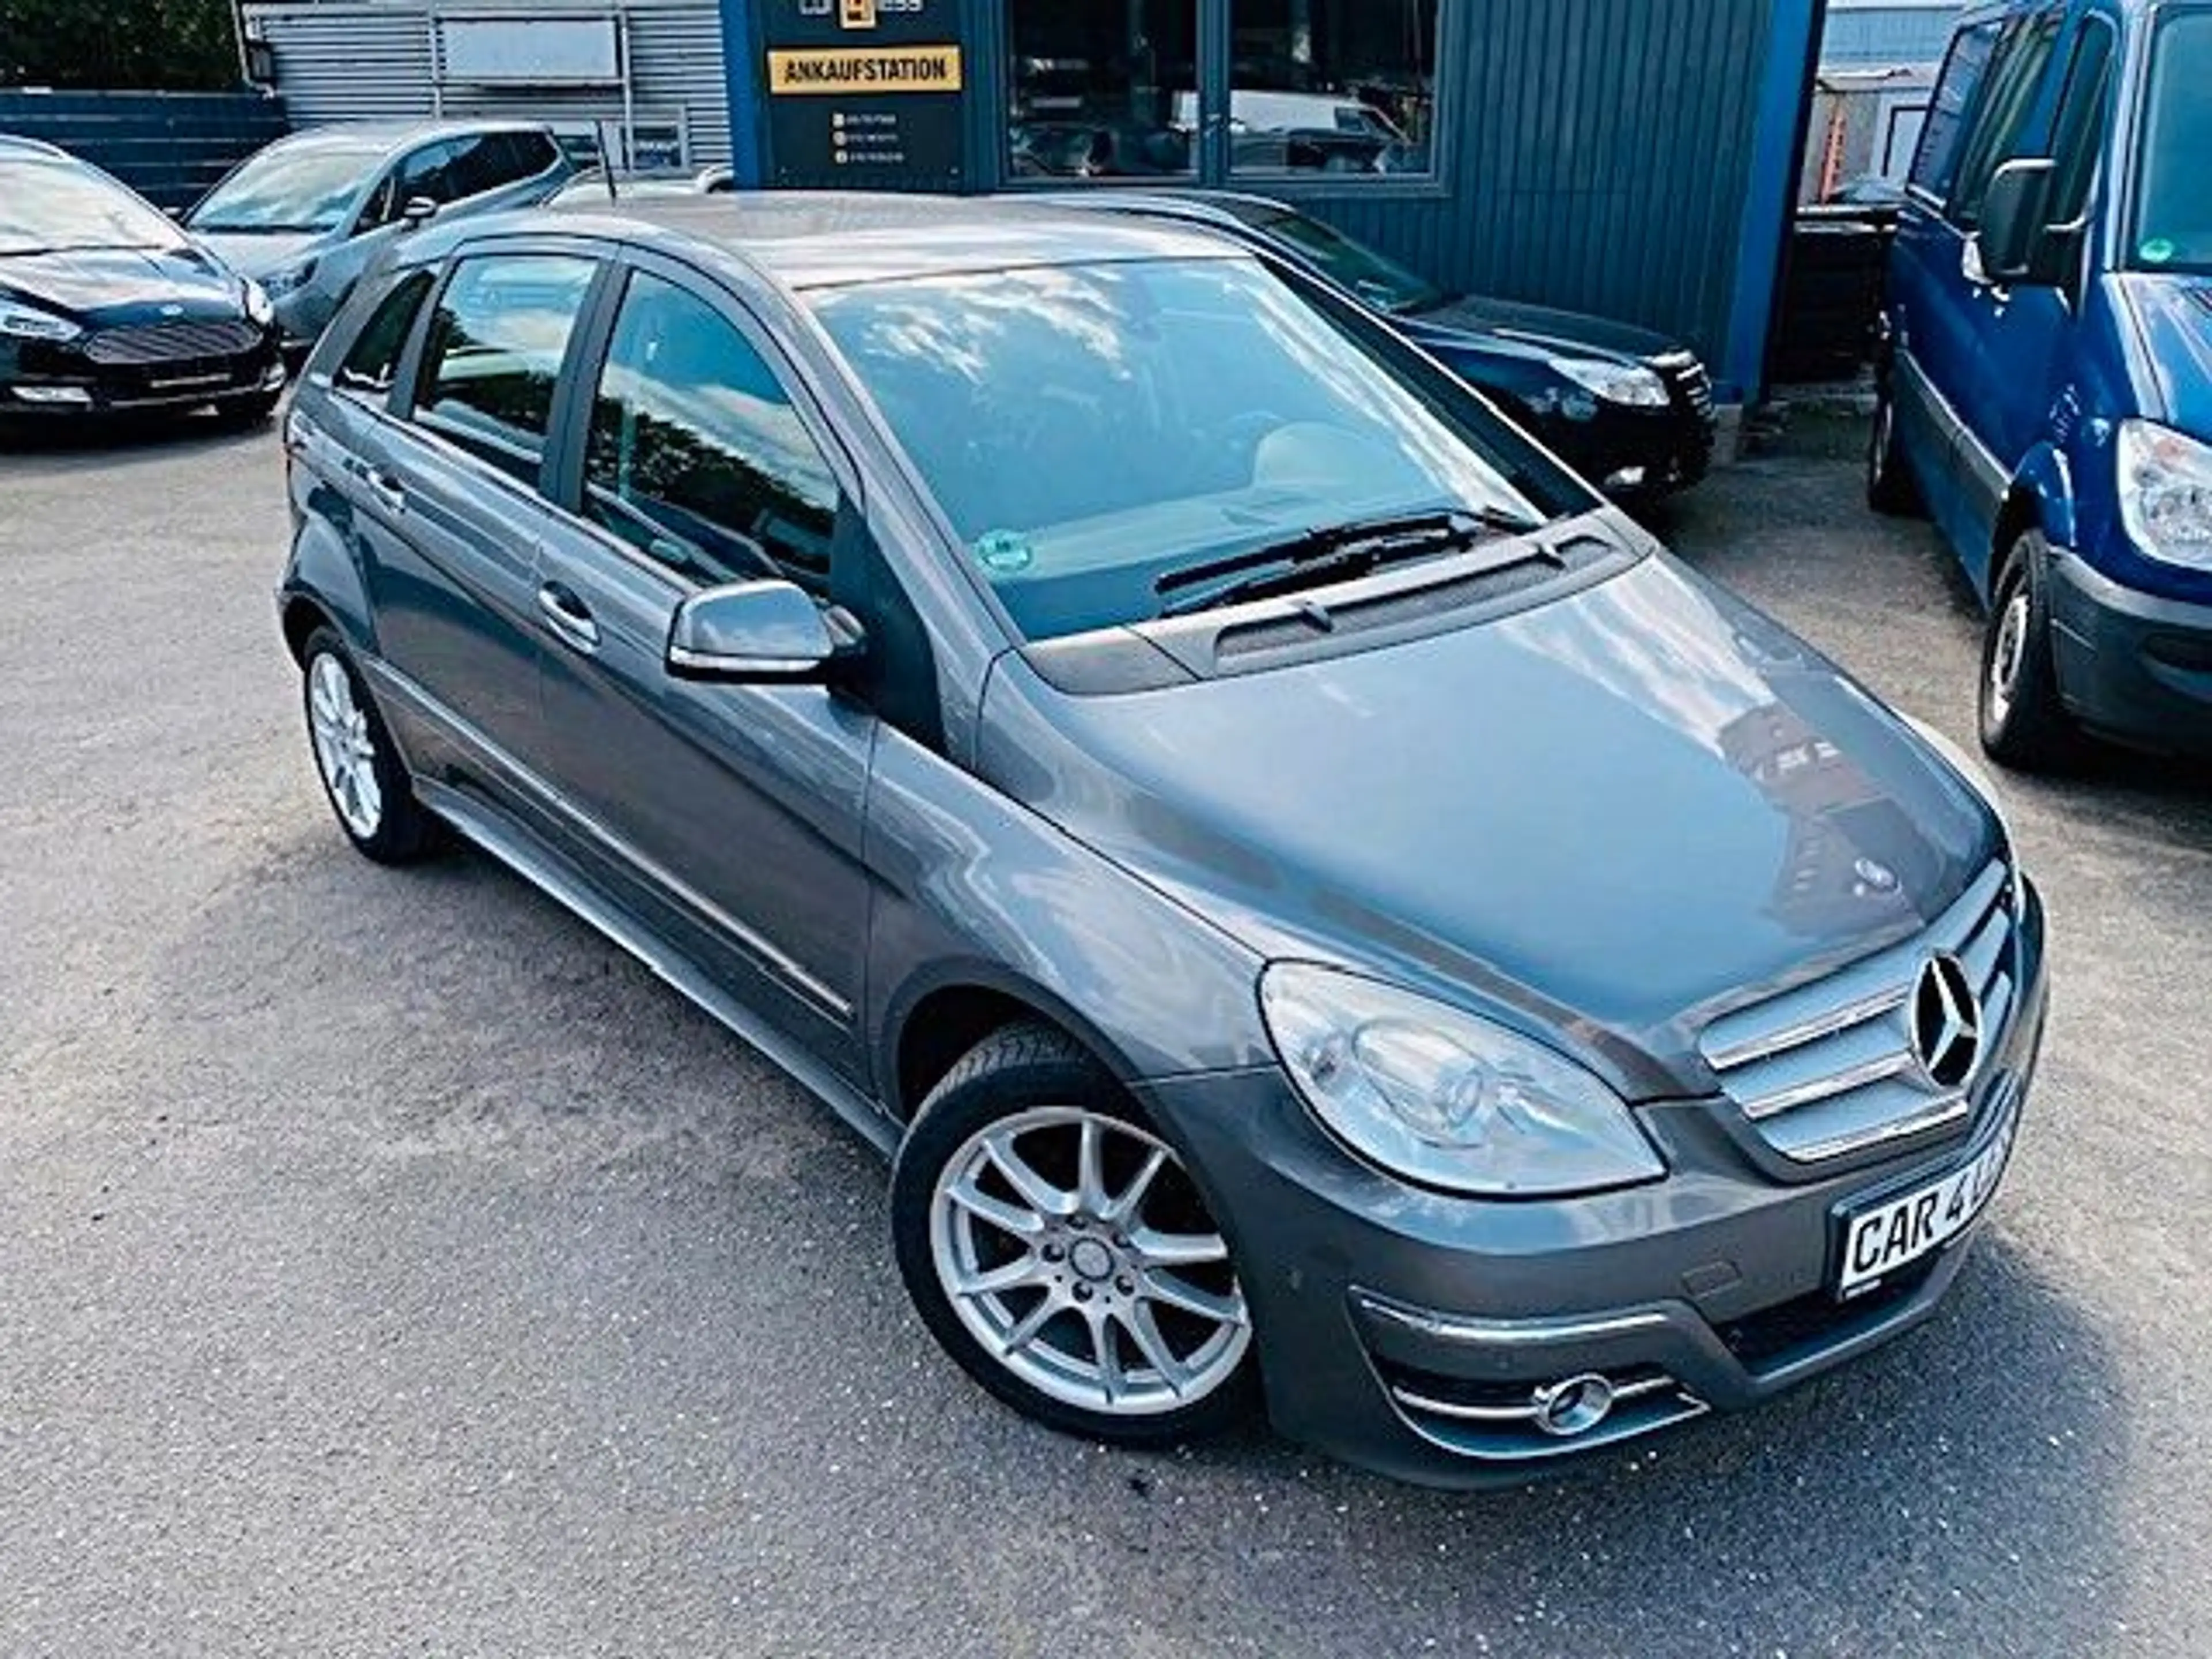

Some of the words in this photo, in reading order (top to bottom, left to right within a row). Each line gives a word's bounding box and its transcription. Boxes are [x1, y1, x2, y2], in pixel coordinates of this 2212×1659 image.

[784, 56, 946, 84] ANKAUFSTATION
[1853, 1191, 1940, 1272] CAR
[1945, 1172, 1969, 1221] 4
